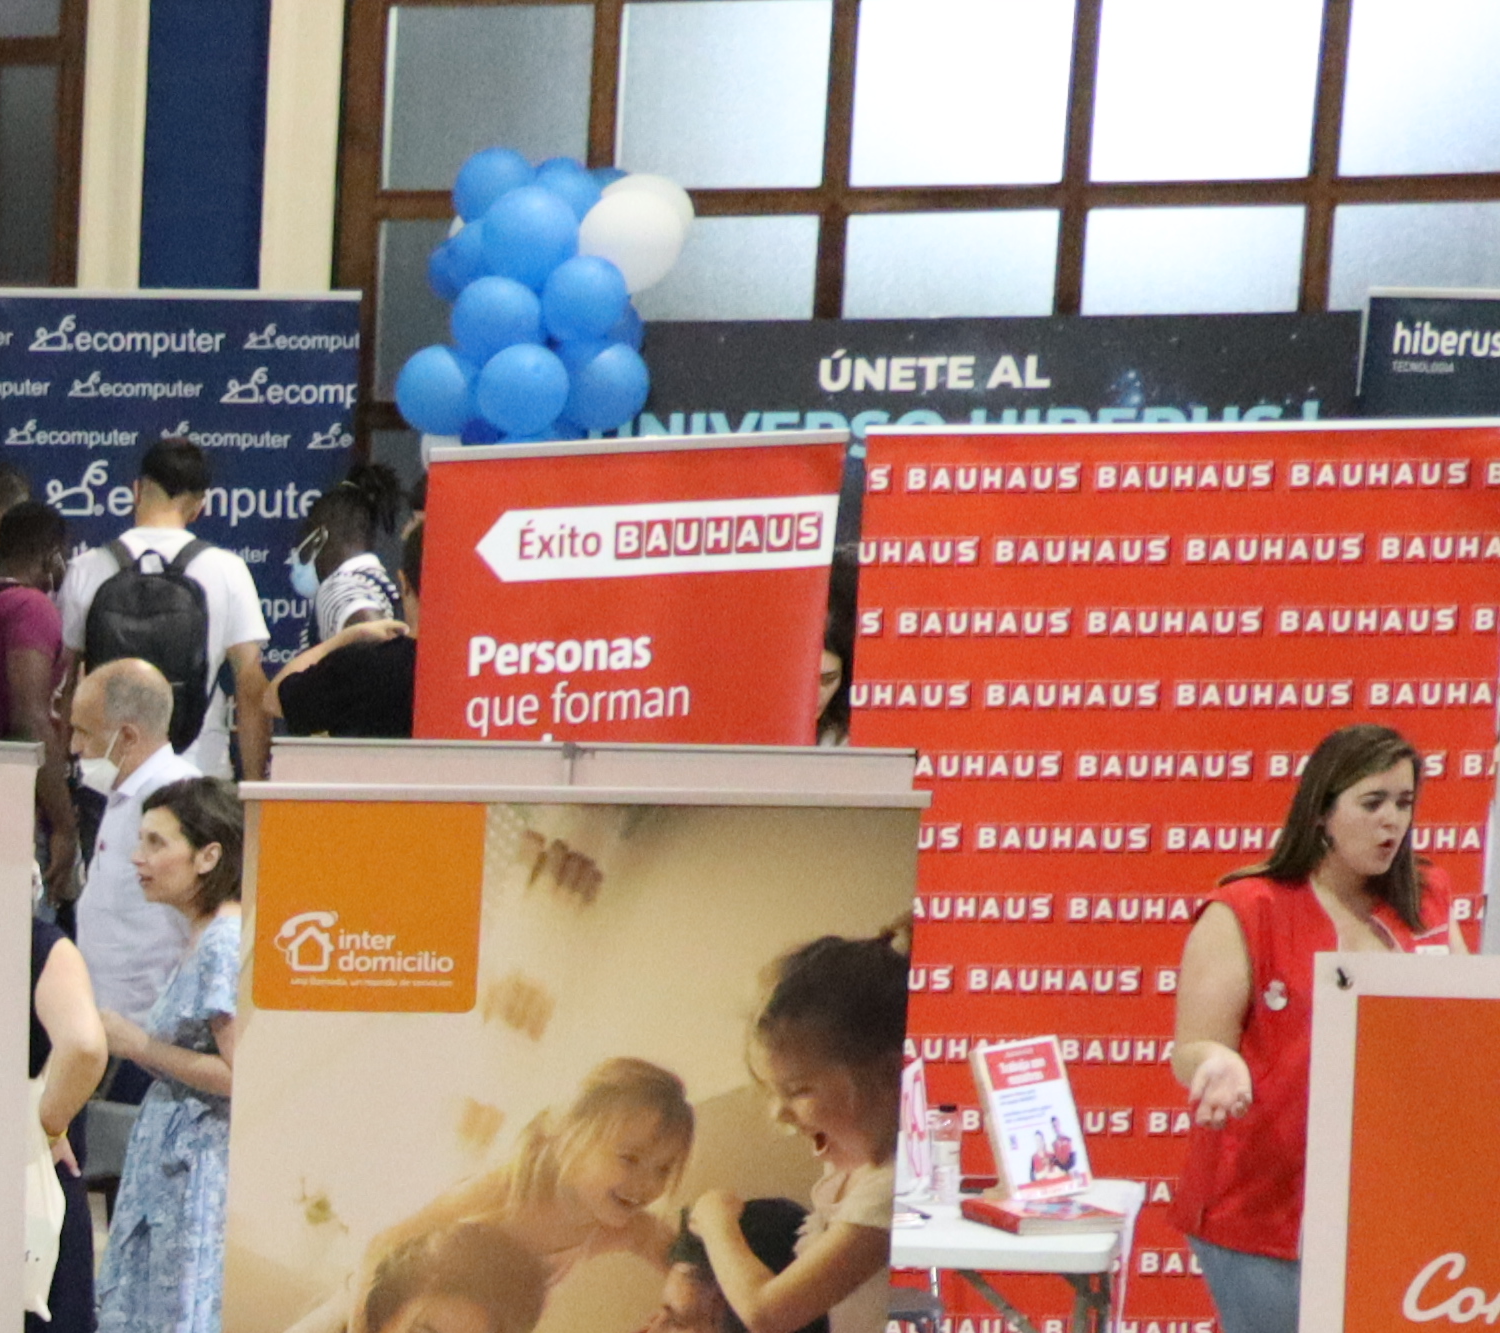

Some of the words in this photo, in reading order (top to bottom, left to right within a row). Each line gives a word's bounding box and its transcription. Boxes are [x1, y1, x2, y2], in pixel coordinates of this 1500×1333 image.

[75, 330, 226, 357] ecomputer
[1393, 321, 1500, 357] hiberus
[819, 349, 975, 392] ÚNETE
[987, 354, 1051, 388] AL
[100, 380, 202, 399] ecomputer
[266, 383, 357, 408] ecomp
[36, 428, 139, 447] ecomputer
[188, 431, 290, 450] ecomputer
[908, 464, 1079, 489] BAUHAUS
[1098, 462, 1272, 488] BAUHAUS
[1291, 461, 1467, 486] BAUHAUS
[518, 520, 602, 561] Éxito
[617, 513, 820, 557] BAUHAUS
[859, 538, 978, 563] UHAUS
[996, 536, 1168, 562] BAUHAUS
[1187, 536, 1362, 561] BAUHAUS
[1382, 534, 1500, 560] BAUHA
[899, 609, 1070, 633] BAUHAUS
[1088, 608, 1260, 633] BAUHAUS
[1280, 607, 1456, 633] BAUHAUS
[467, 635, 652, 676] Personas
[987, 682, 1158, 706] BAUHAUS
[1177, 682, 1351, 706] BAUHAUS
[1371, 681, 1492, 706] BAUHA
[466, 694, 540, 736] que
[550, 681, 690, 724] forman
[1079, 753, 1251, 777] BAUHAUS
[978, 826, 1147, 850] BAUHAUS
[338, 929, 396, 950] inter
[338, 951, 454, 973] domicilio
[970, 968, 1139, 991] BAUHAUS
